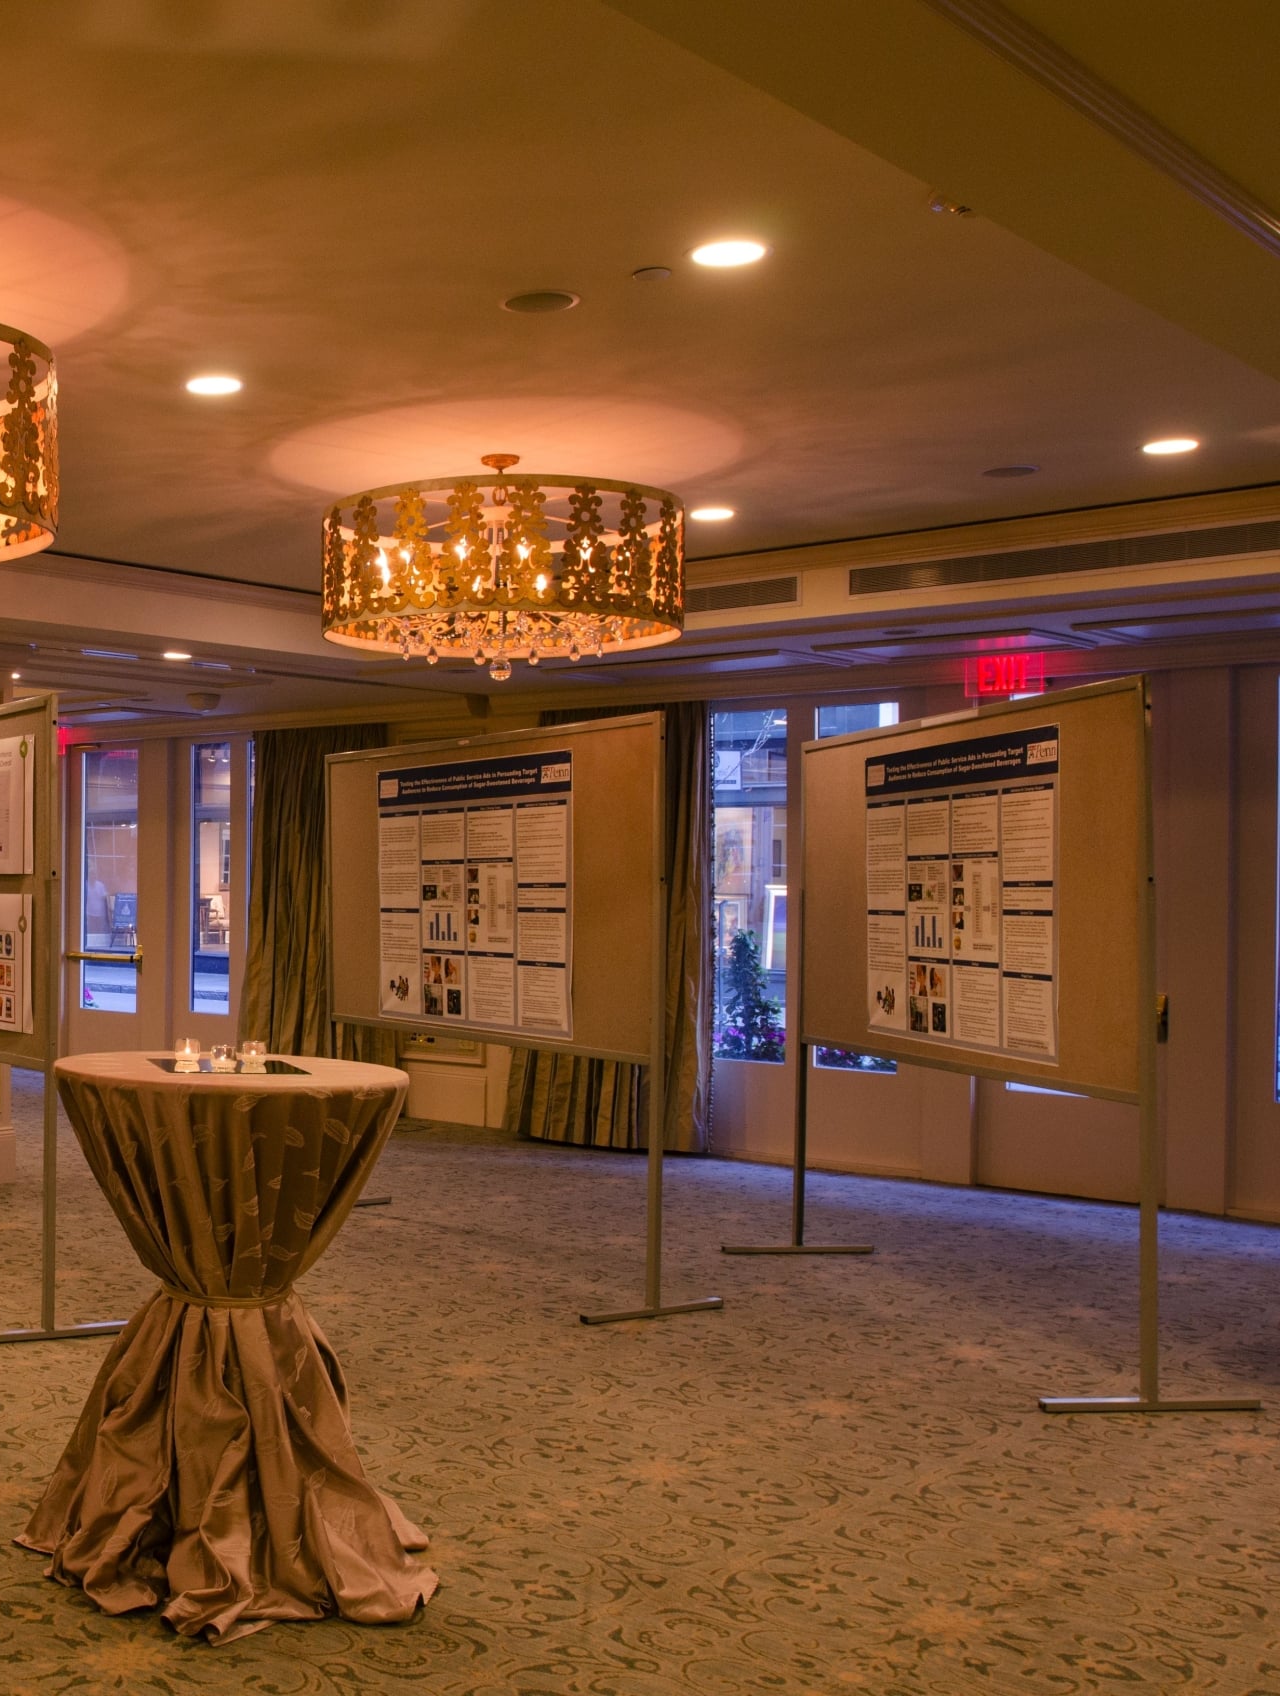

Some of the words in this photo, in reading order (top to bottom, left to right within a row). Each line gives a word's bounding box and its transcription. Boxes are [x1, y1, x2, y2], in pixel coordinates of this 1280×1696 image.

[978, 655, 1029, 692] EXIT
[907, 762, 933, 771] Effectiveness
[937, 758, 950, 766] Public
[951, 756, 967, 764] Service
[982, 749, 1007, 758] Persuading
[1007, 747, 1023, 756] Target
[912, 771, 927, 779] Reduce
[926, 767, 952, 777] Consumption
[996, 758, 1021, 767] Beverages
[441, 783, 468, 791] Consumption
[511, 777, 536, 785] Beverages
[452, 774, 465, 782] Public
[497, 769, 522, 777] Persuading
